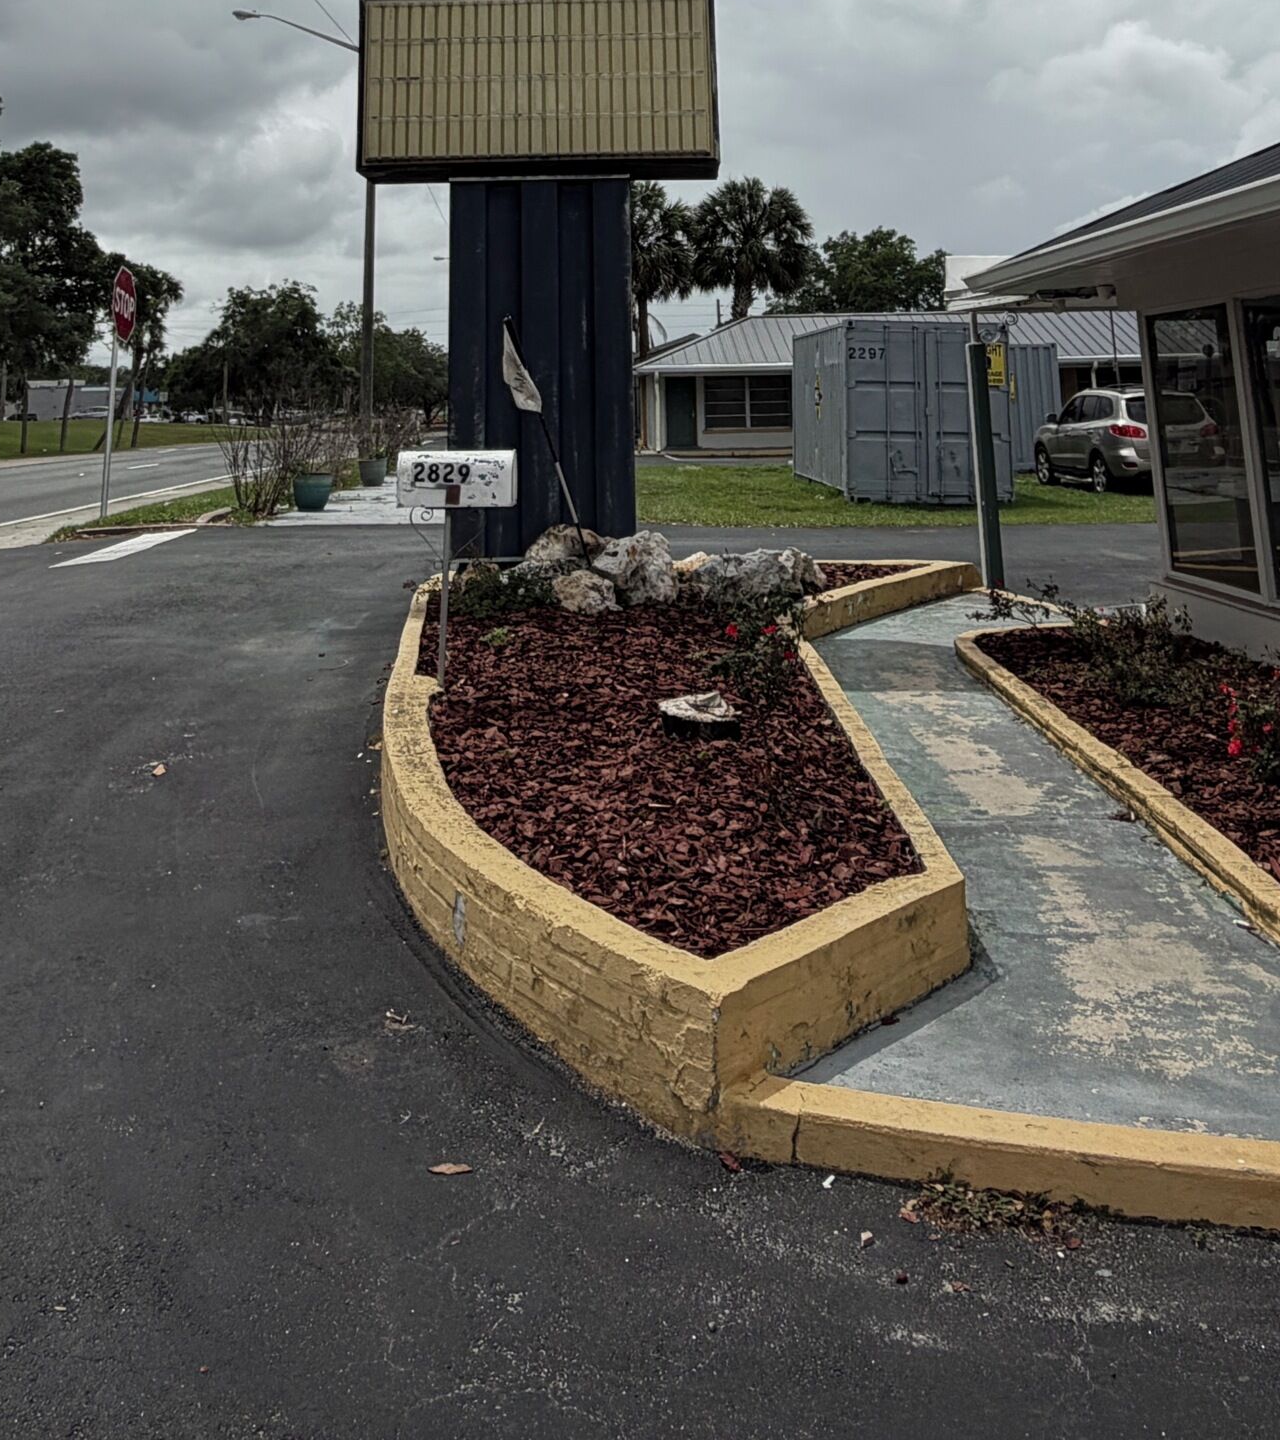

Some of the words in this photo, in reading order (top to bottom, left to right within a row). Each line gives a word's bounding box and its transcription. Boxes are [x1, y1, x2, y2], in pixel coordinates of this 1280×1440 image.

[115, 286, 135, 321] STOP
[848, 347, 885, 360] 2297
[986, 344, 1002, 357] GHT
[413, 463, 471, 484] 2829
